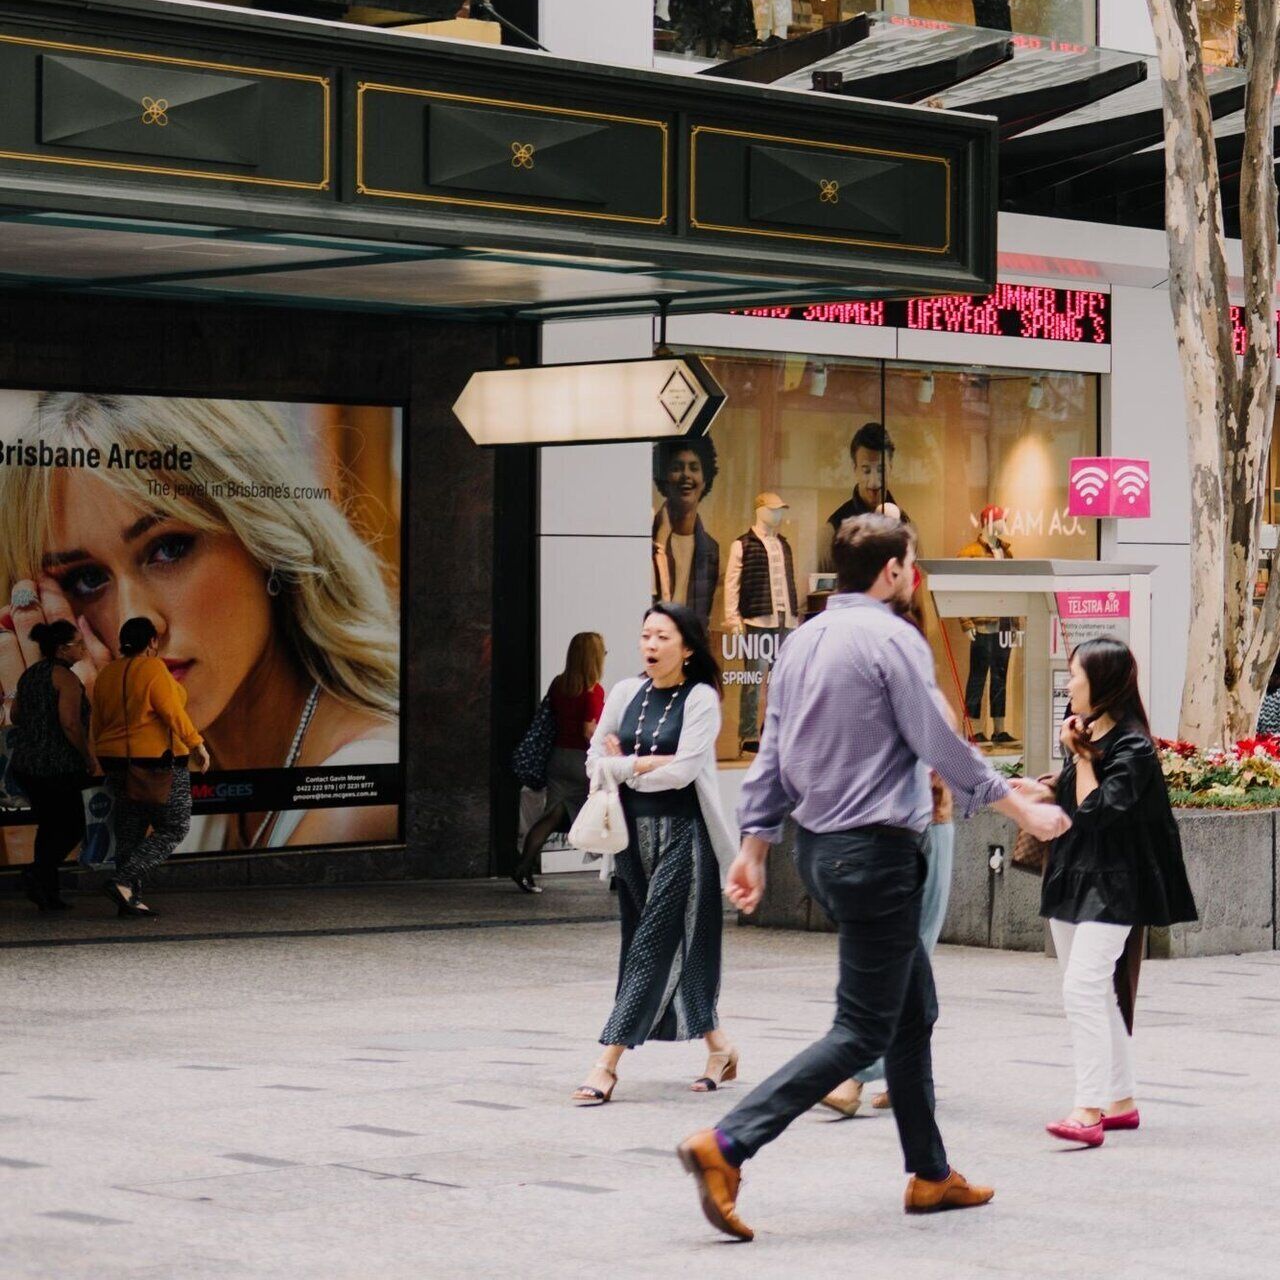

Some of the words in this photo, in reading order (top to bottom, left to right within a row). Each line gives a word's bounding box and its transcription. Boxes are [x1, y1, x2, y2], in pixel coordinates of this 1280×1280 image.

[107, 443, 193, 471] Arcade
[149, 479, 171, 497] The
[172, 480, 209, 501] jewel
[211, 481, 223, 498] in
[227, 481, 291, 499] Brisbane's
[293, 487, 332, 501] crown
[1068, 600, 1102, 614] TELSTRA
[722, 671, 763, 685] SPRING
